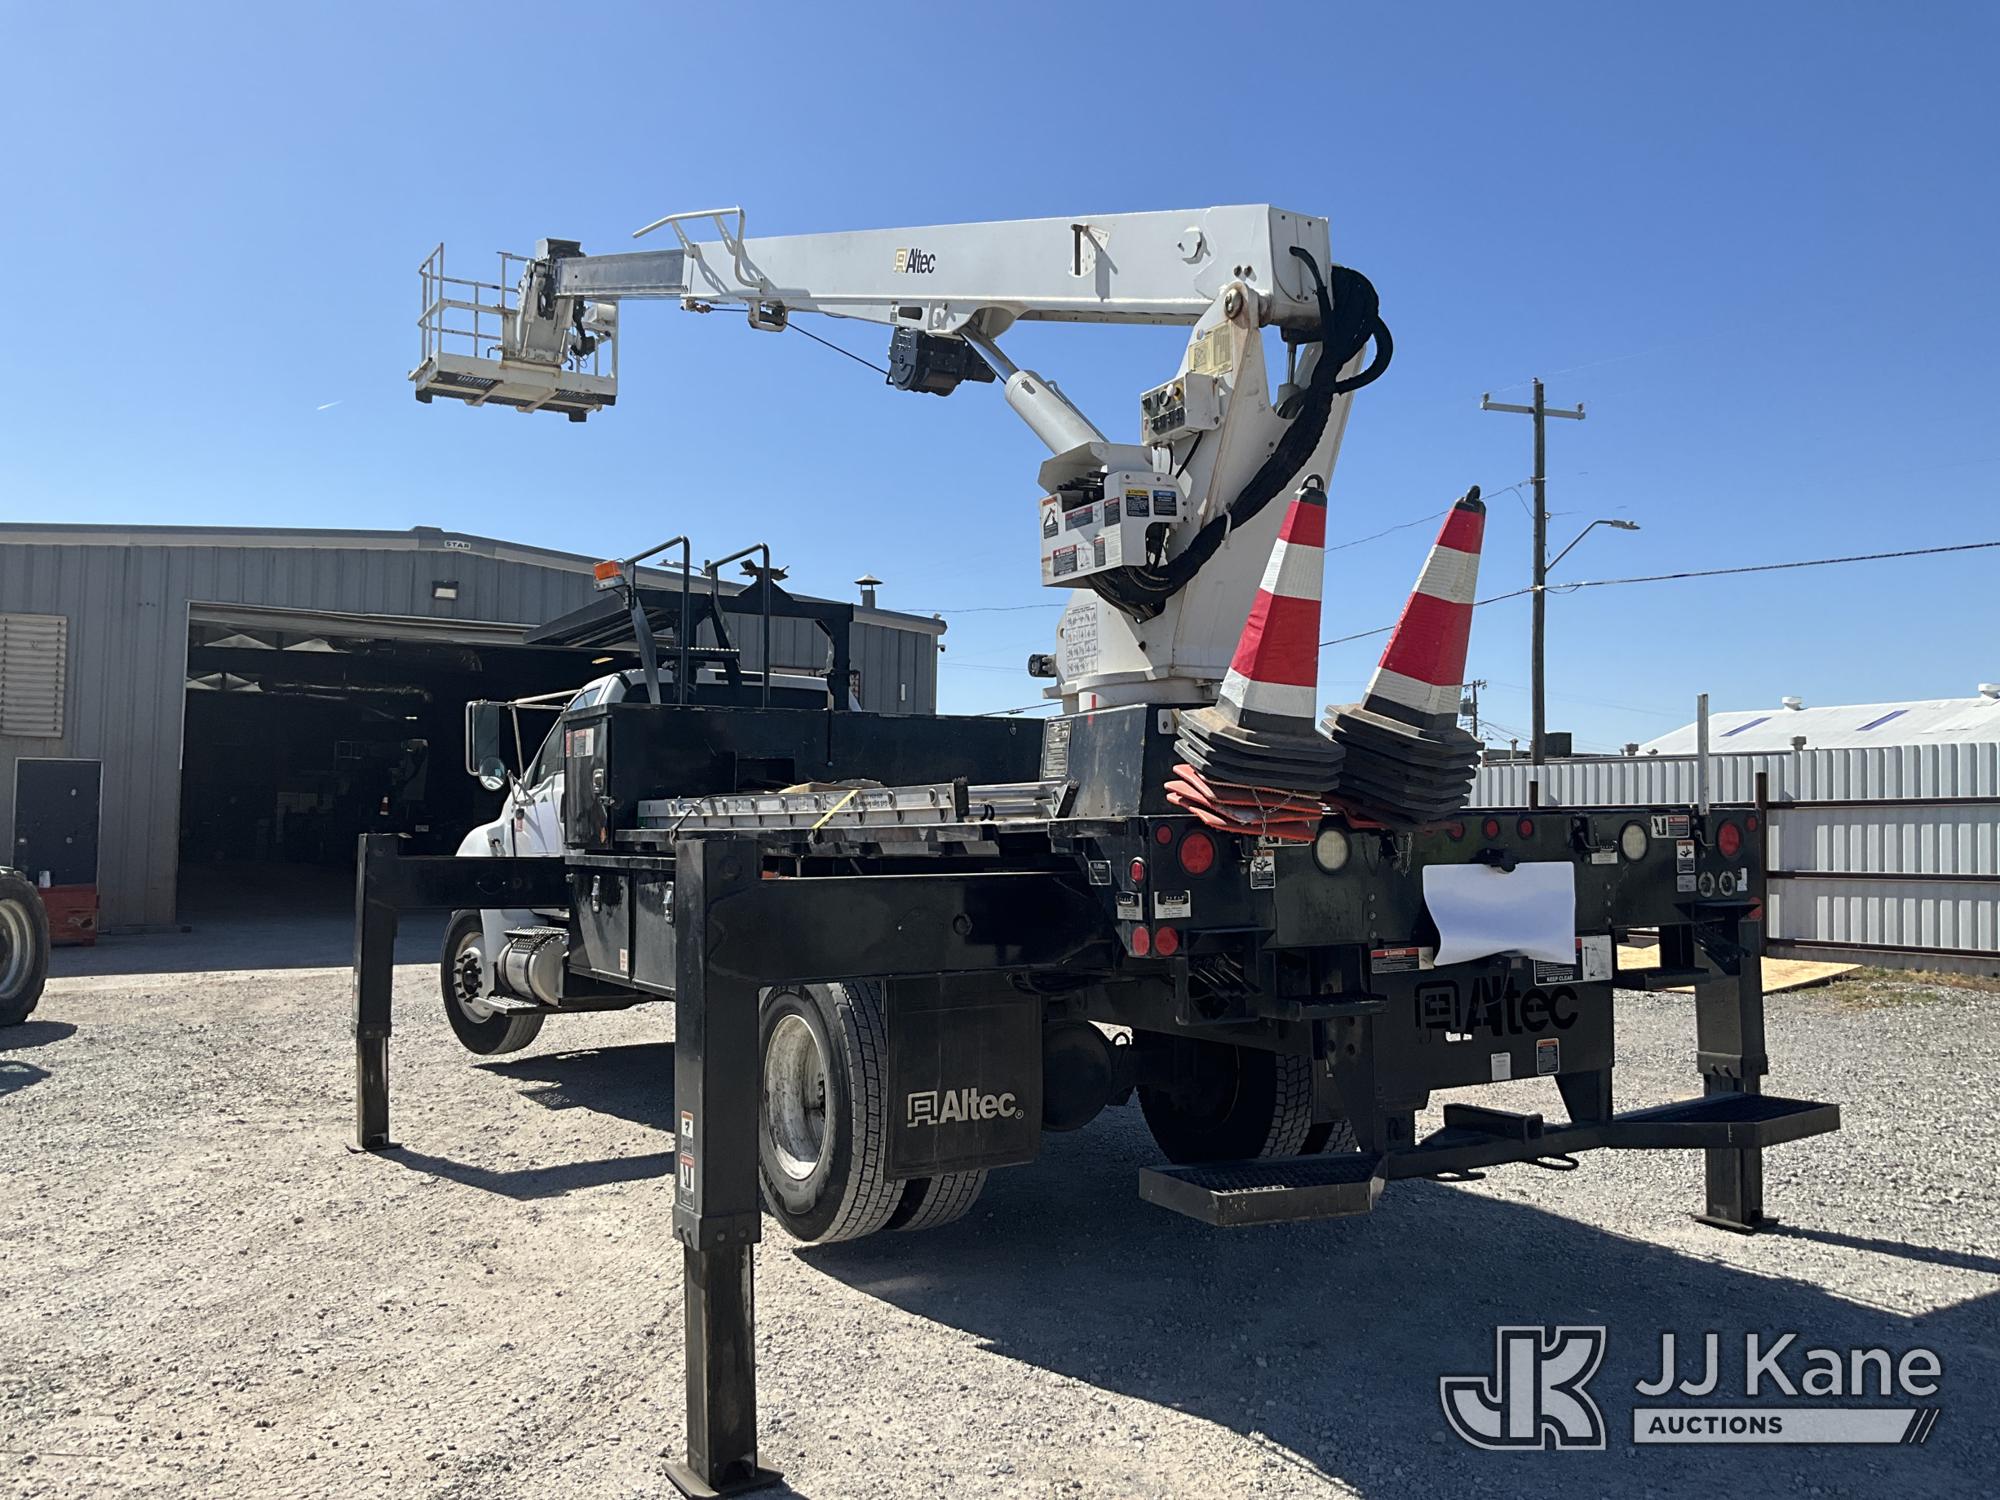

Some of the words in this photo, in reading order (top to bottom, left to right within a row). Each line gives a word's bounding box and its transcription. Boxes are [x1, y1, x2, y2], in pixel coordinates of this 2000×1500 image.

[905, 248, 936, 273] Altec
[1465, 976, 1578, 1037] Altec
[939, 1087, 1017, 1124] Altec
